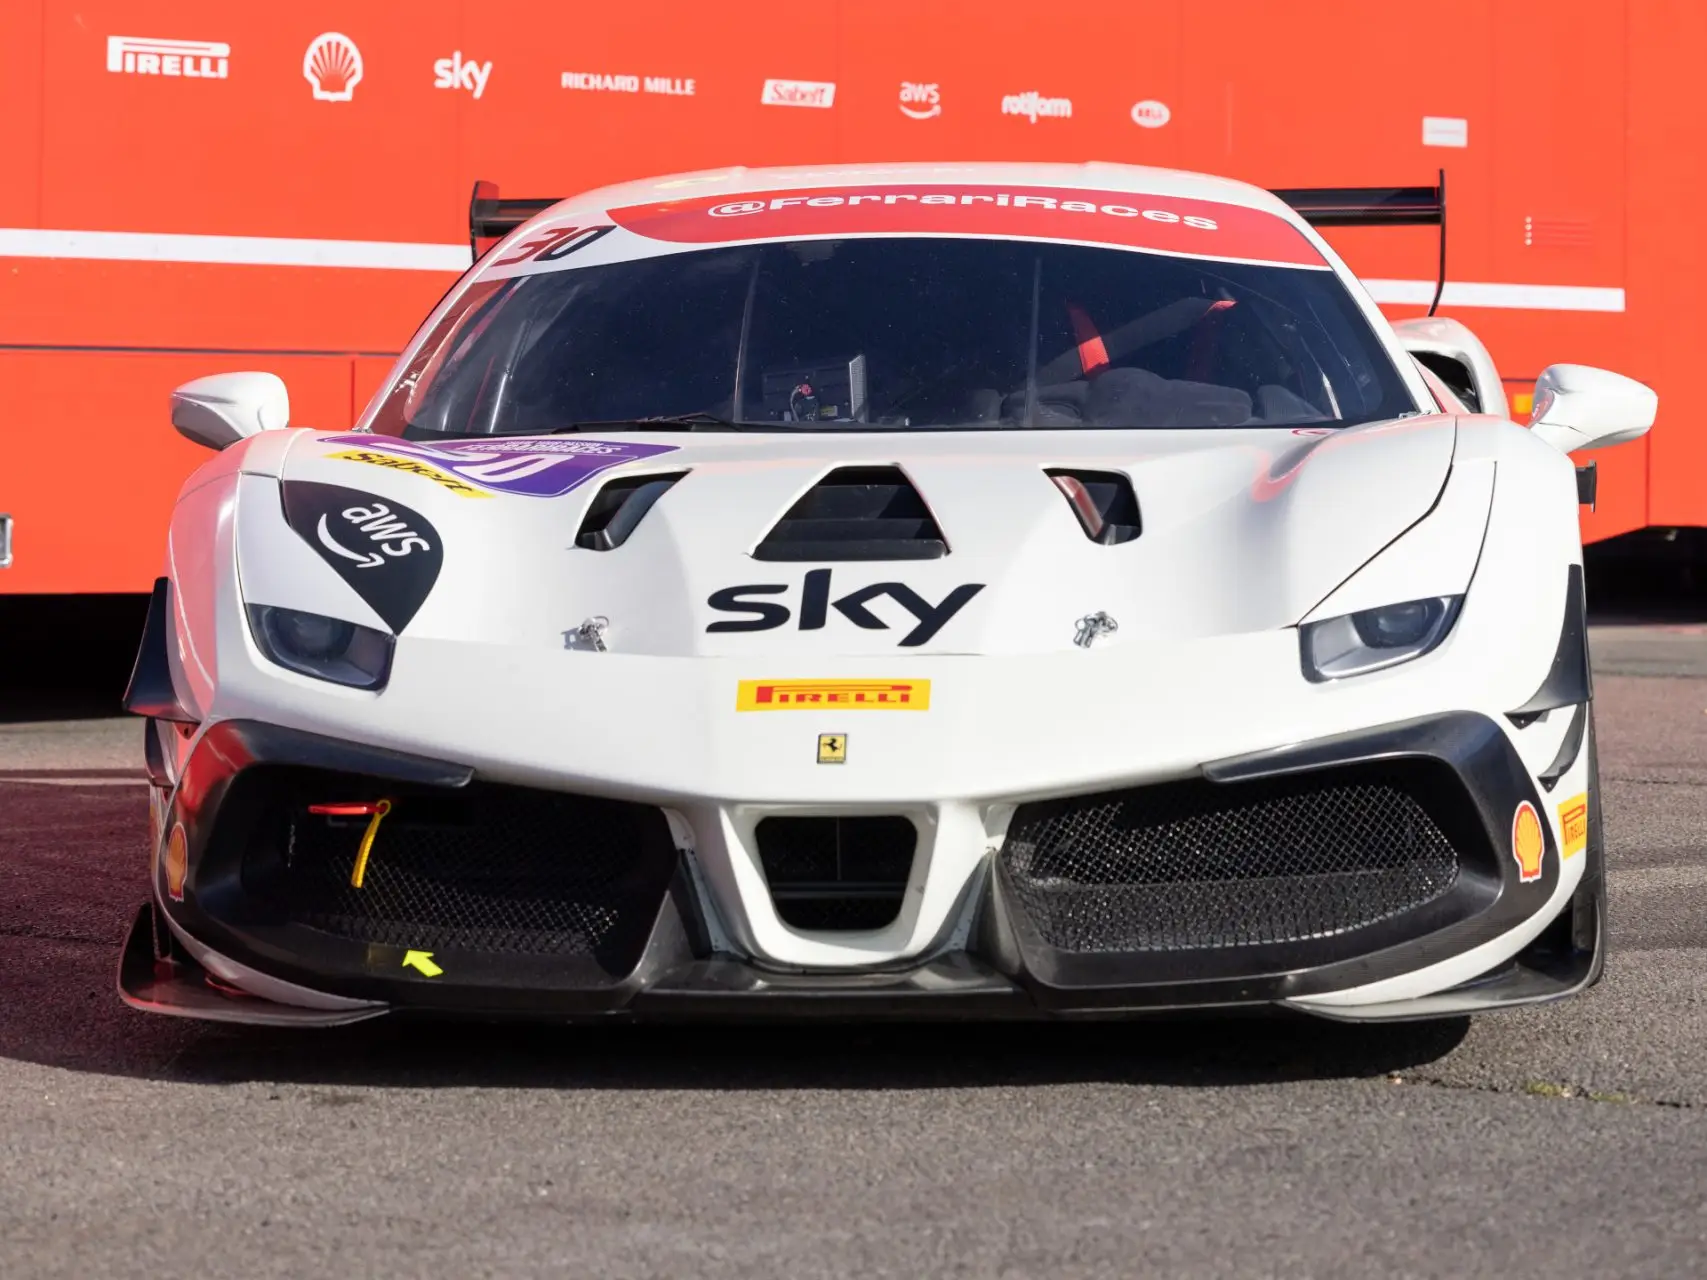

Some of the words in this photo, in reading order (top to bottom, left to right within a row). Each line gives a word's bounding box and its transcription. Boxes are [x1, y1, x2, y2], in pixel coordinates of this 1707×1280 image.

[106, 35, 230, 79] PIRELLI
[434, 52, 492, 99] sky
[560, 71, 639, 94] RICHARD
[643, 75, 695, 96] MILLE
[899, 81, 941, 105] aws
[707, 193, 1219, 231] @FerrariRaces
[490, 225, 618, 267] 30
[341, 503, 431, 557] aws
[706, 568, 987, 647] sky
[755, 685, 912, 703] PIRELLI
